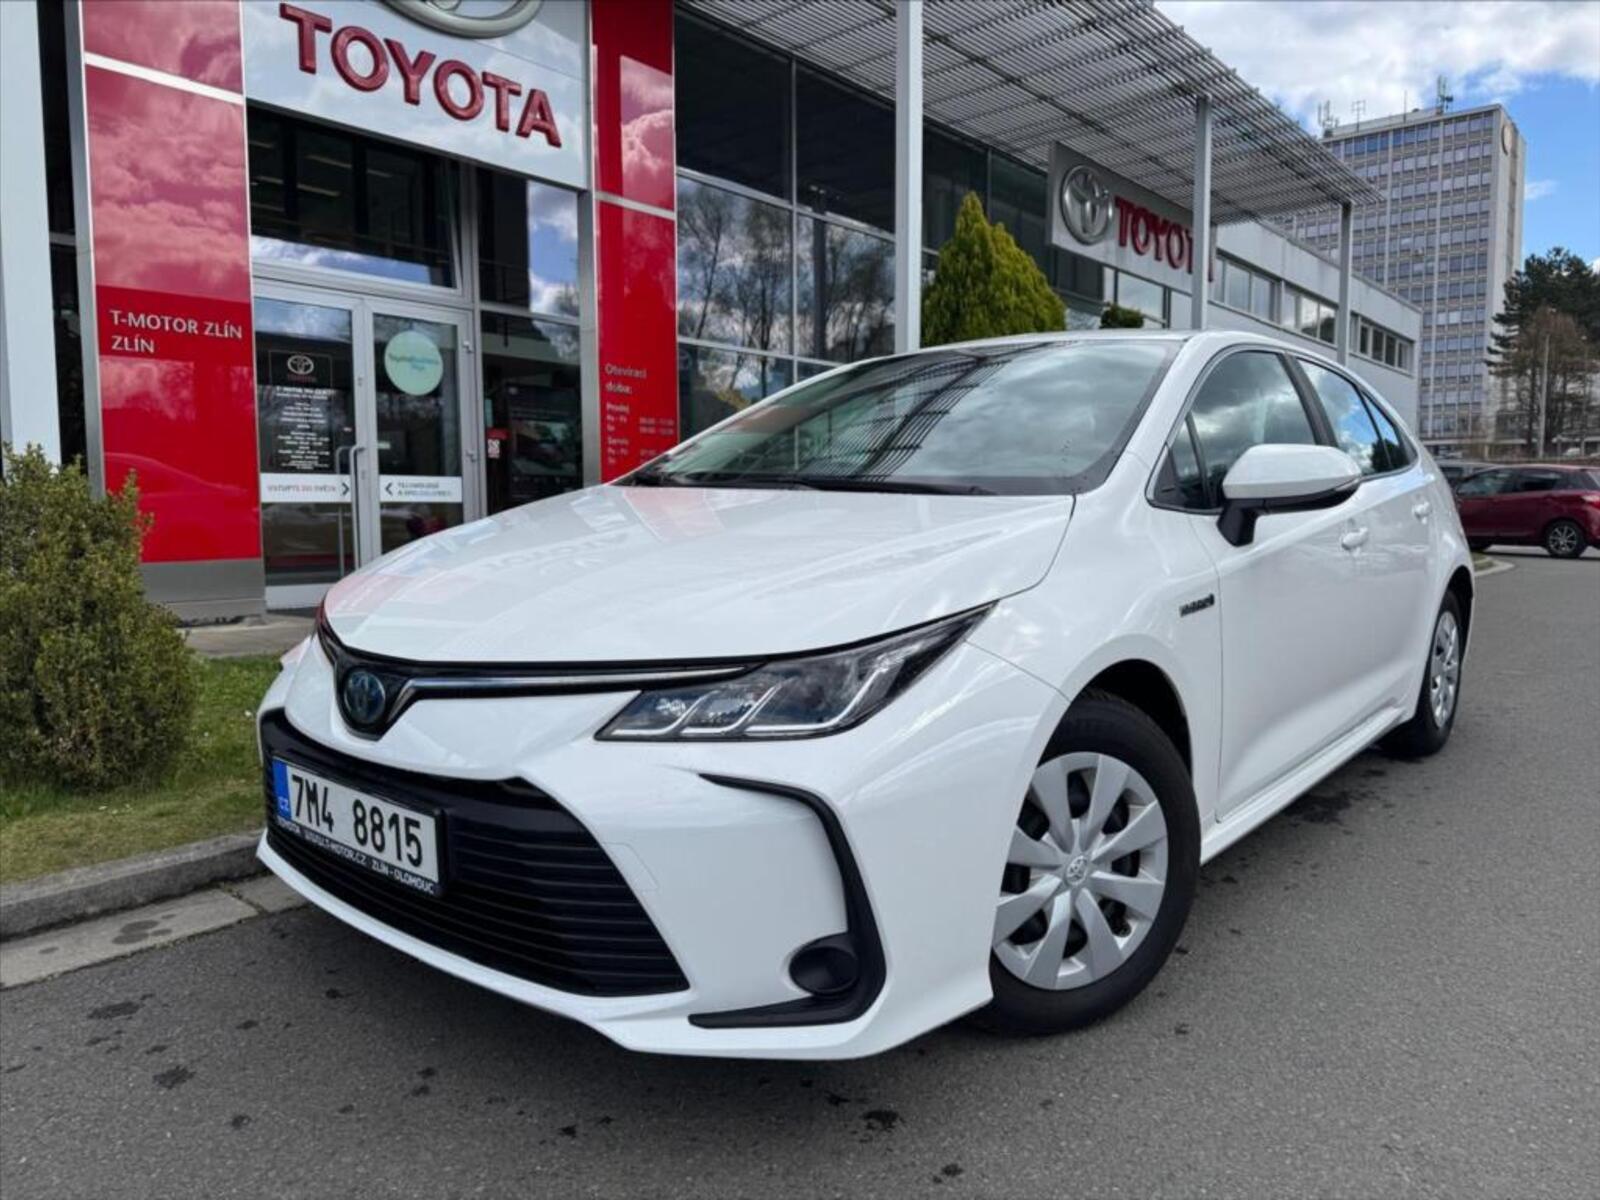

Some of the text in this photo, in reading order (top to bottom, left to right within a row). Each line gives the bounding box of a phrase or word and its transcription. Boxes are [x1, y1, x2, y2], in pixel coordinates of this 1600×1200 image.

[280, 3, 561, 148] TOYOTA
[109, 309, 242, 339] T-MOTOR ZLÍN
[111, 333, 154, 354] ZLÍN
[292, 774, 423, 867] 7M4 8815
